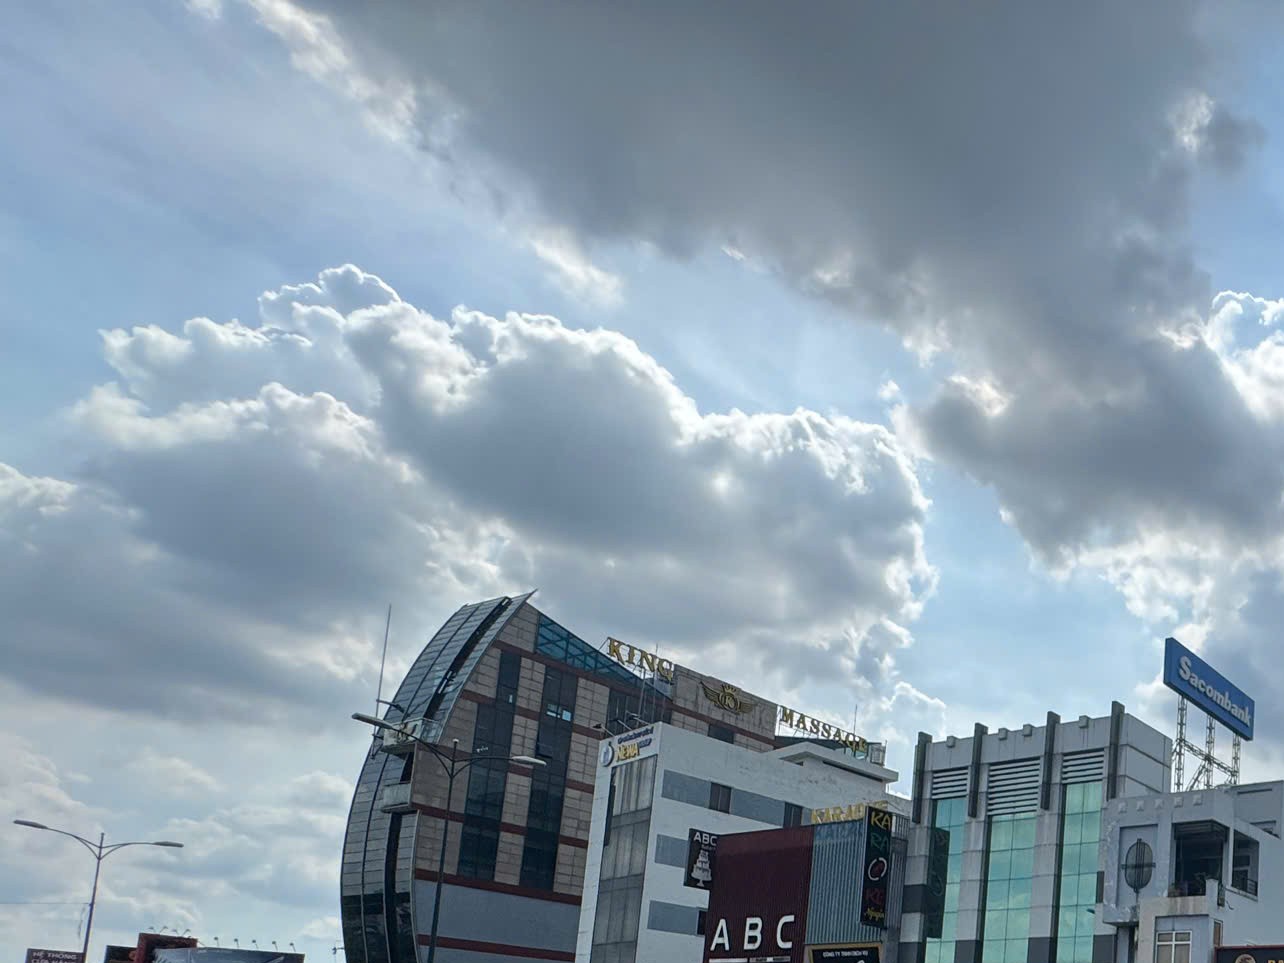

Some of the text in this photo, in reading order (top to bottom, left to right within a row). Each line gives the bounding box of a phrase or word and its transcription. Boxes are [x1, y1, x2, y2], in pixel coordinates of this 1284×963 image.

[607, 638, 674, 682] KING
[1179, 656, 1252, 725] Sacombank
[780, 707, 868, 751] MASSAGE
[693, 831, 718, 846] ABC
